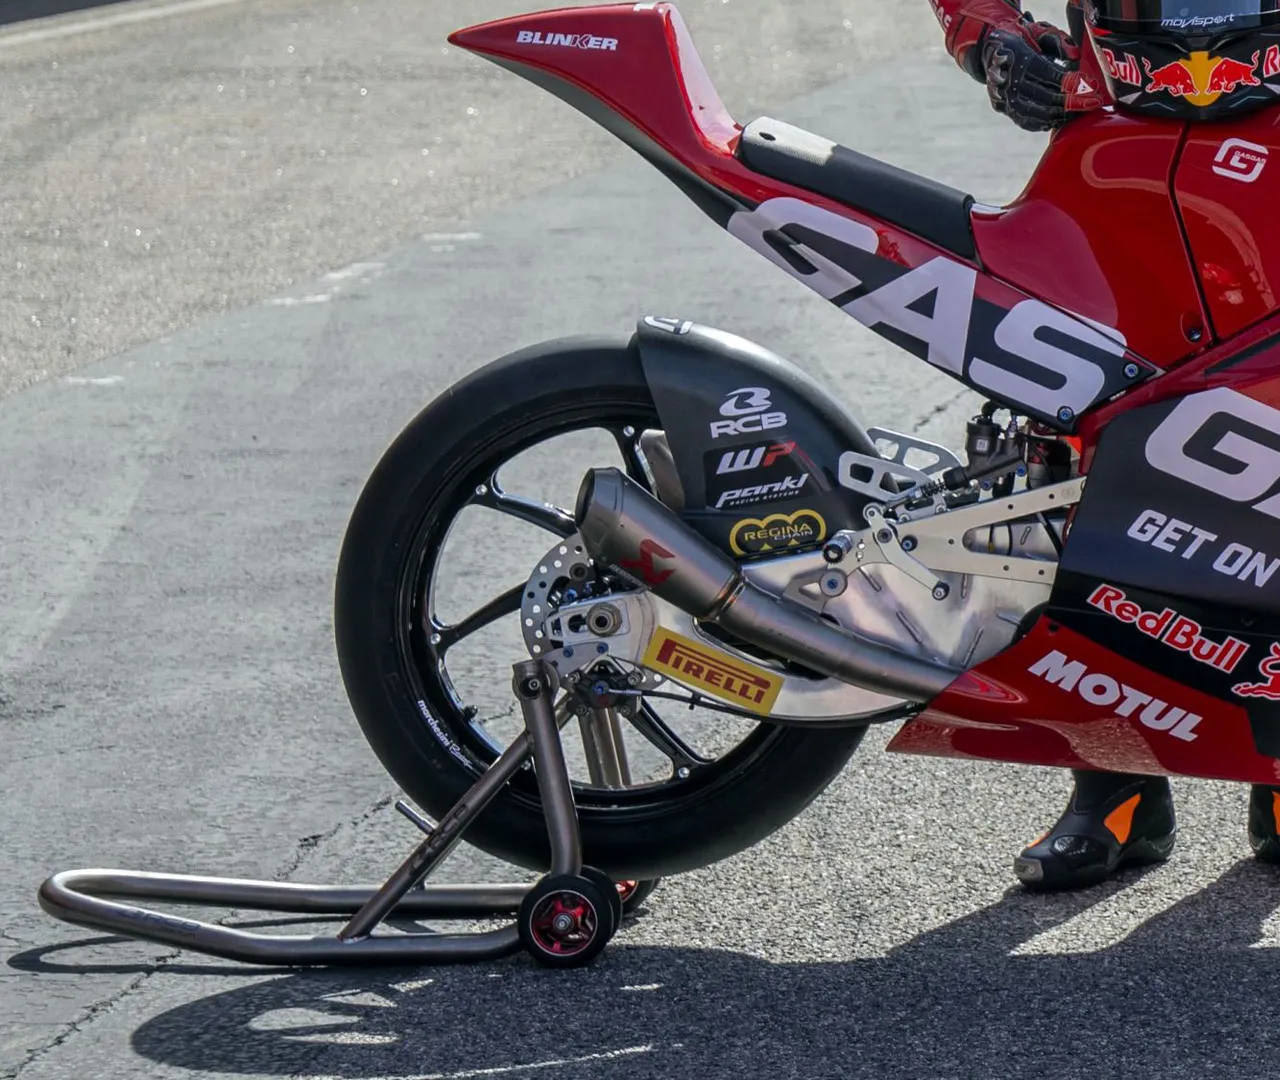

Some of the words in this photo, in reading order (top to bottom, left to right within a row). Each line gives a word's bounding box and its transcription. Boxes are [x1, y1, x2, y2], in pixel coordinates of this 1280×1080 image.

[516, 29, 618, 52] BLINKER
[1101, 47, 1142, 87] Bull
[726, 197, 1127, 418] GAS
[710, 412, 788, 438] RCB
[716, 441, 798, 476] WP
[715, 473, 809, 508] pankl
[744, 523, 812, 542] REGINA
[774, 529, 814, 542] CHAIN
[1126, 508, 1218, 560] GET
[1087, 583, 1169, 644] Red
[1164, 610, 1251, 674] Bull
[655, 636, 771, 705] PIRELLI
[1027, 649, 1204, 742] MOTUL
